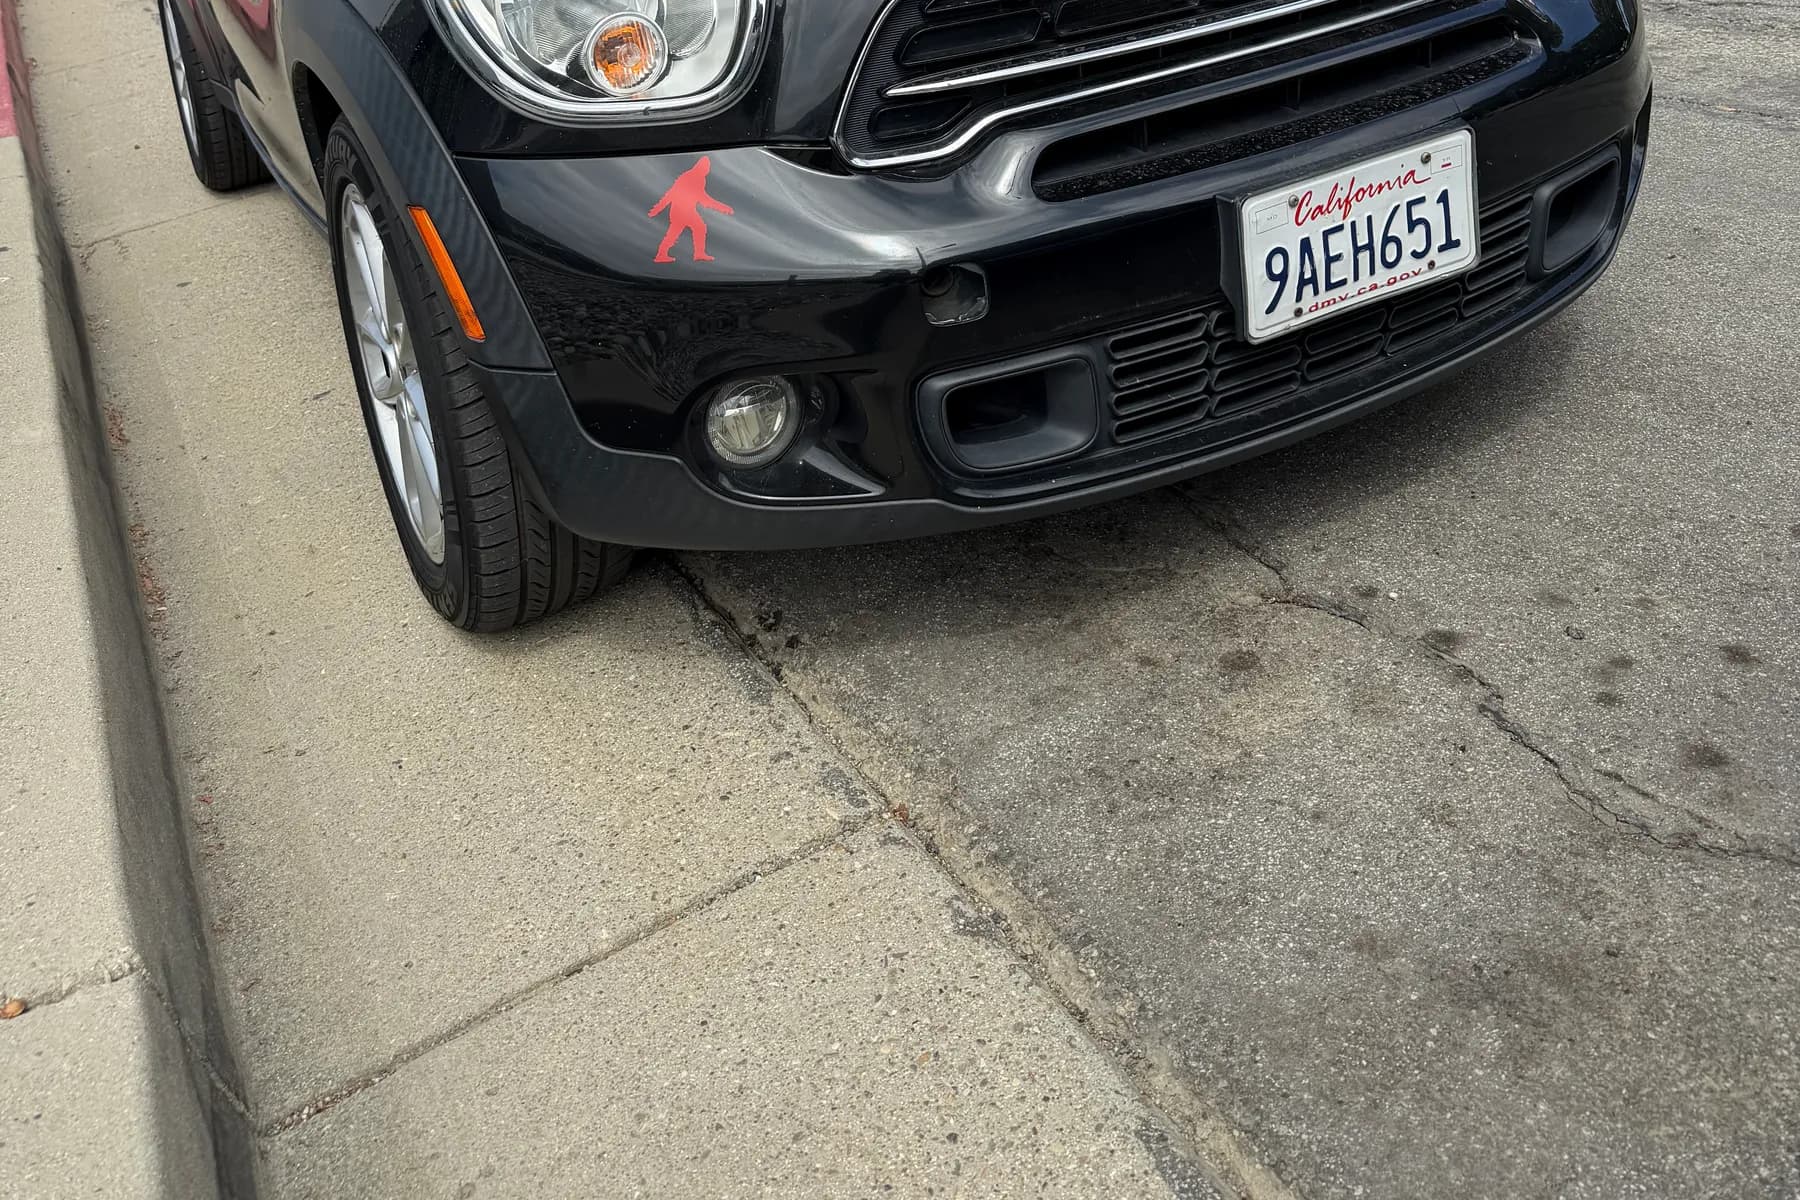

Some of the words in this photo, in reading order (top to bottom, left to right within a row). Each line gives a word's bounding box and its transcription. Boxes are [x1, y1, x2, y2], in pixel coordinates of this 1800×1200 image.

[1295, 166, 1431, 226] California
[1264, 188, 1461, 315] 9AEH651
[1307, 267, 1423, 313] dmv.ca.gov
